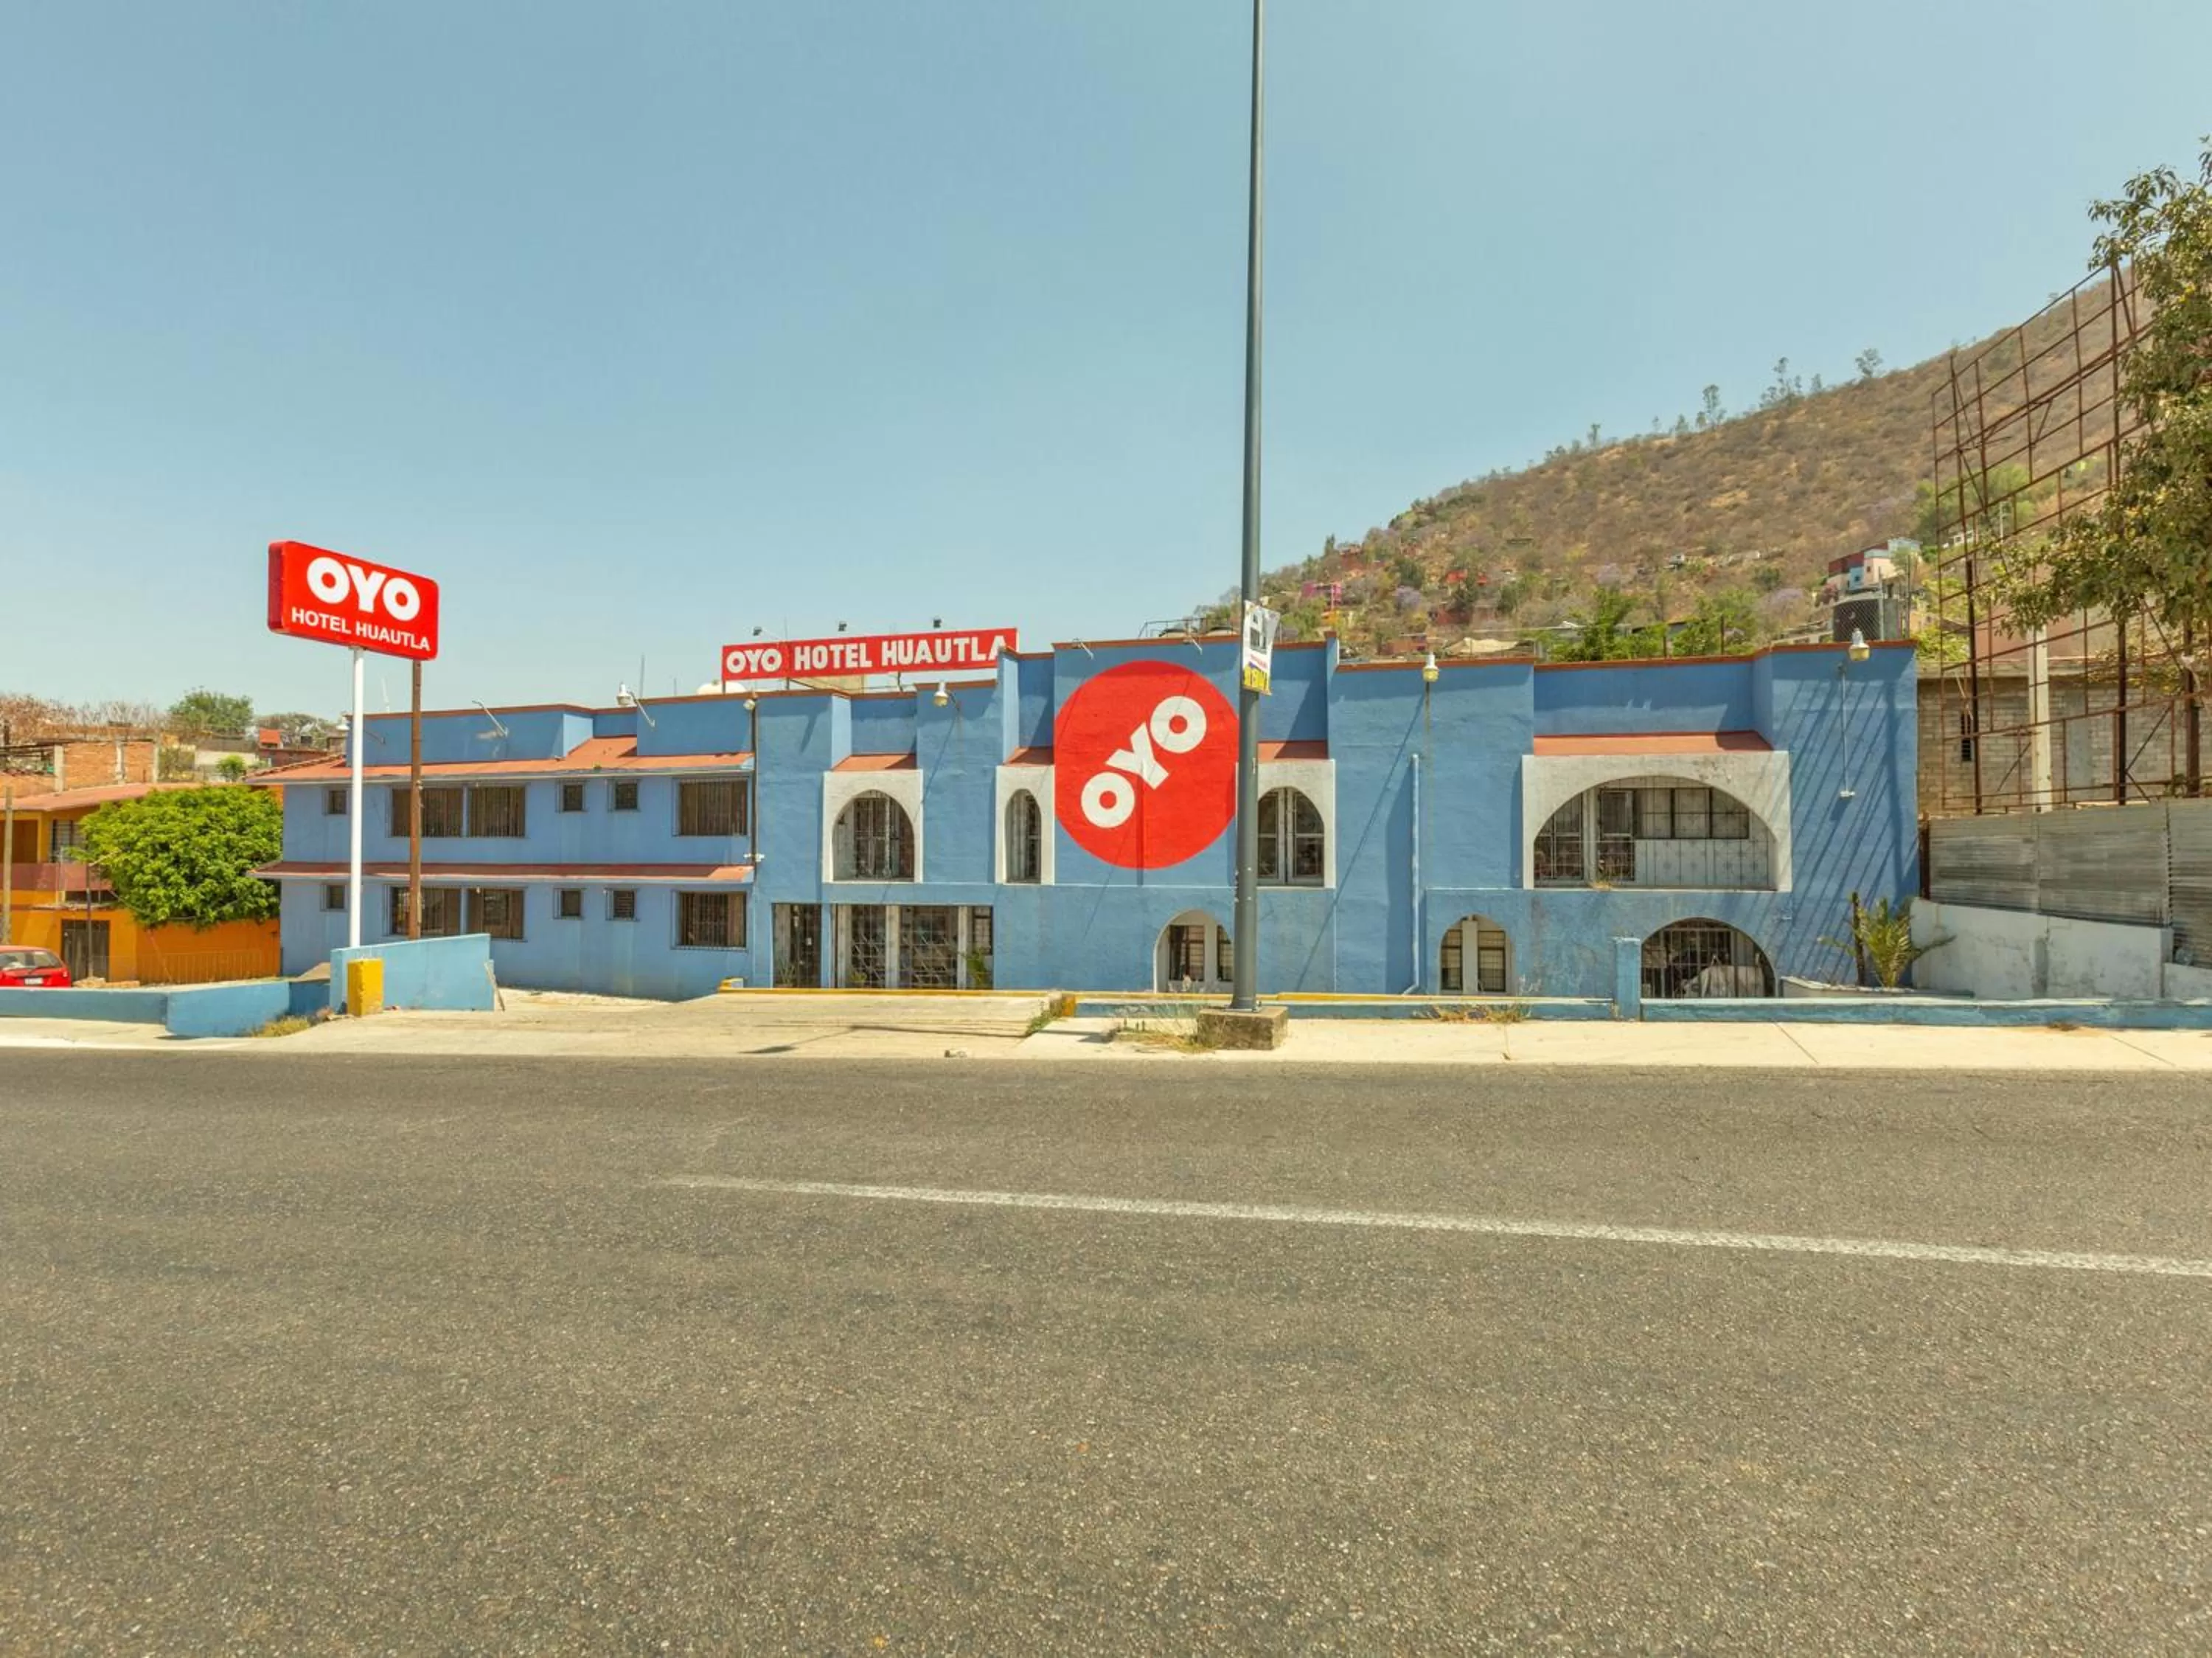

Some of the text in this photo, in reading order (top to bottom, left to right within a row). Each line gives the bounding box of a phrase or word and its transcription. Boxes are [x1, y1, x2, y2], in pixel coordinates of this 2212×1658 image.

[307, 556, 420, 621] OYO
[291, 607, 431, 651] HOTEL HUAUTLA
[726, 648, 782, 673] OYO
[794, 642, 873, 670] HOTEL
[1080, 696, 1207, 829] OYO
